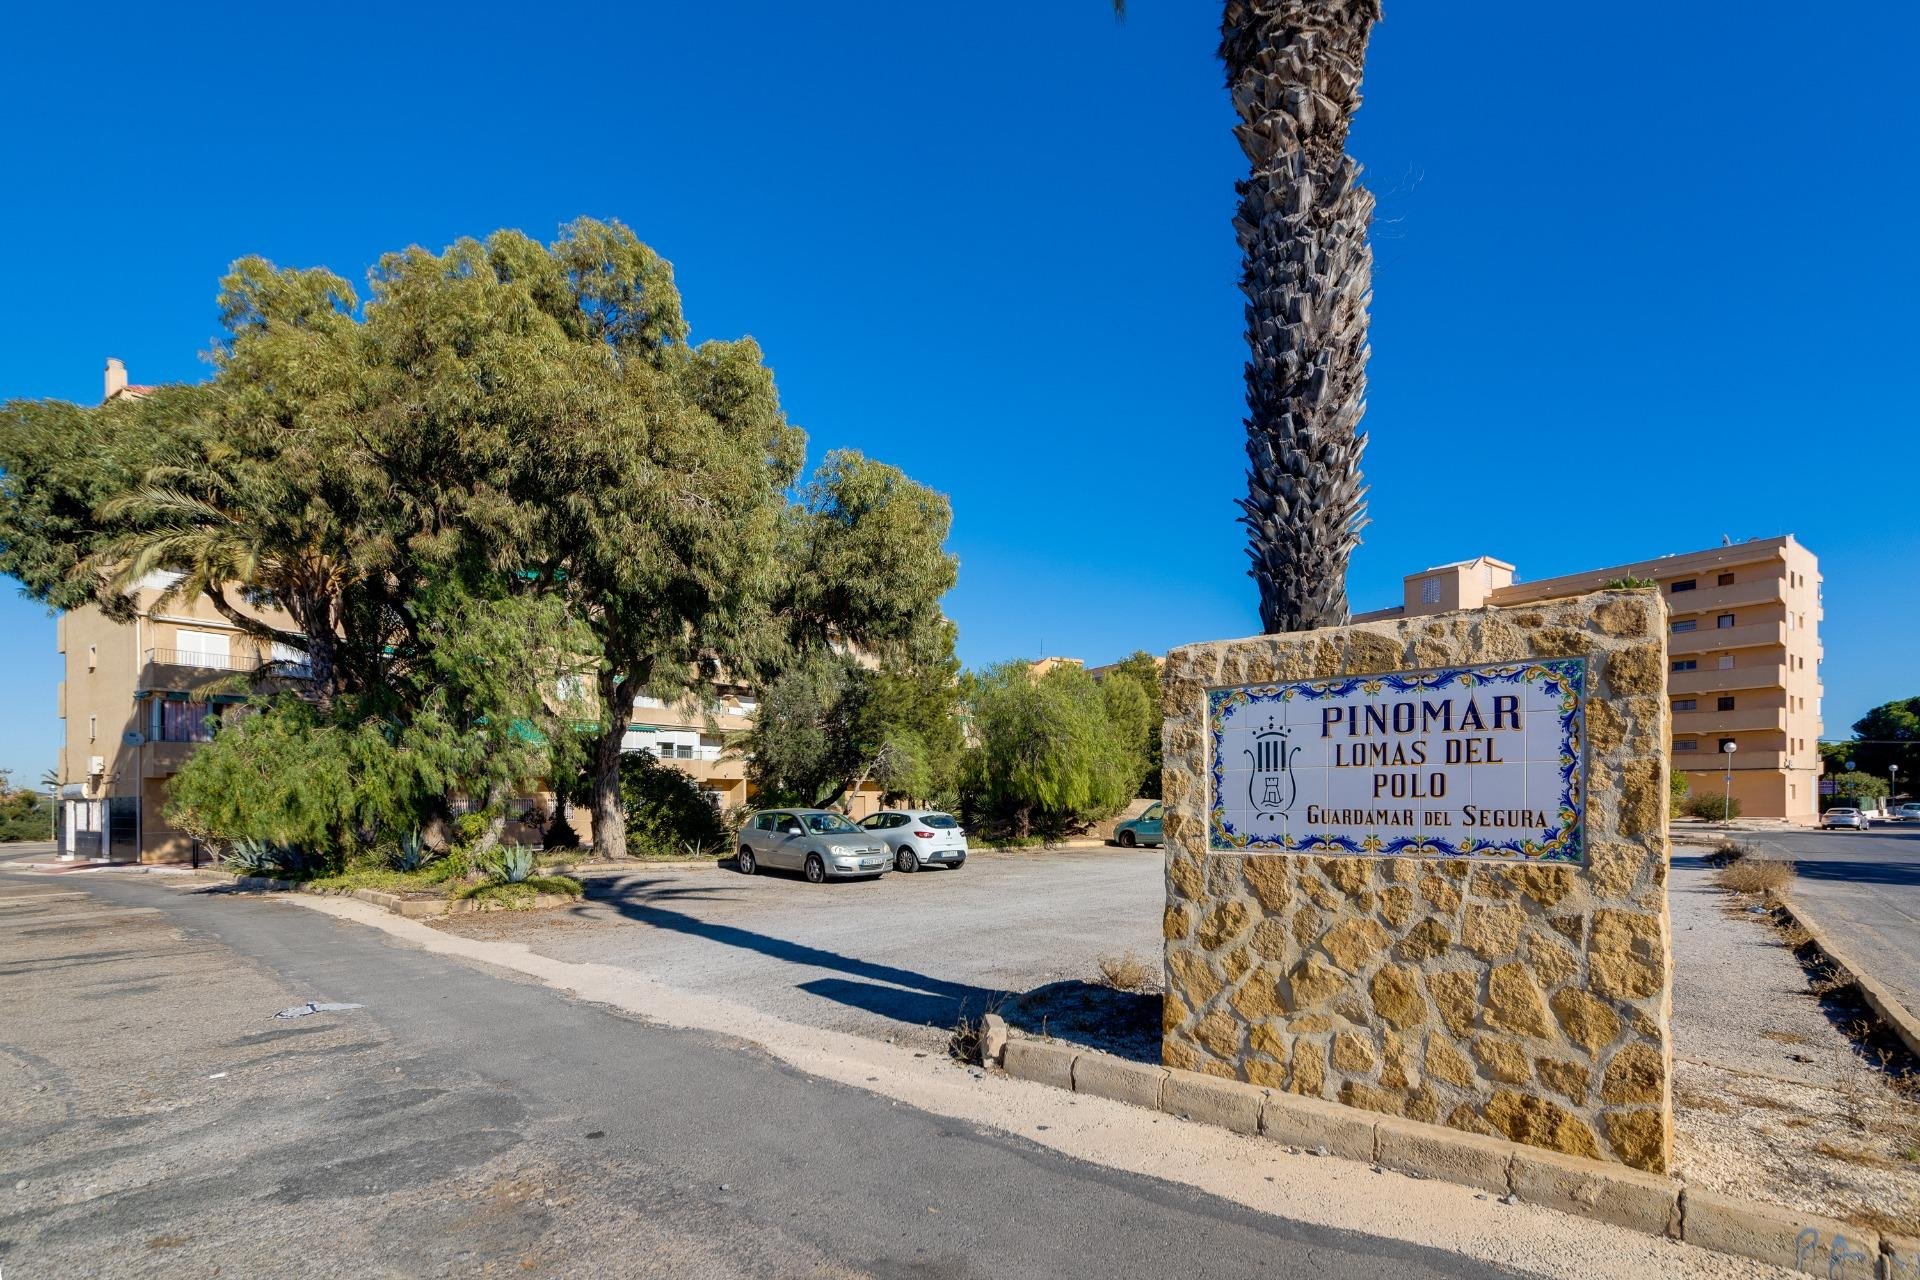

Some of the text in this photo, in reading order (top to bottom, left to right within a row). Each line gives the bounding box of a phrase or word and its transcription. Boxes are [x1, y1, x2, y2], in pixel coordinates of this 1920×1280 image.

[1321, 694, 1523, 738] PINOMAR
[1335, 737, 1503, 768] LOMAS DEL
[1373, 772, 1447, 799] POLO
[1307, 804, 1414, 827] GUARDAMAR
[1462, 804, 1548, 829] SEGURA
